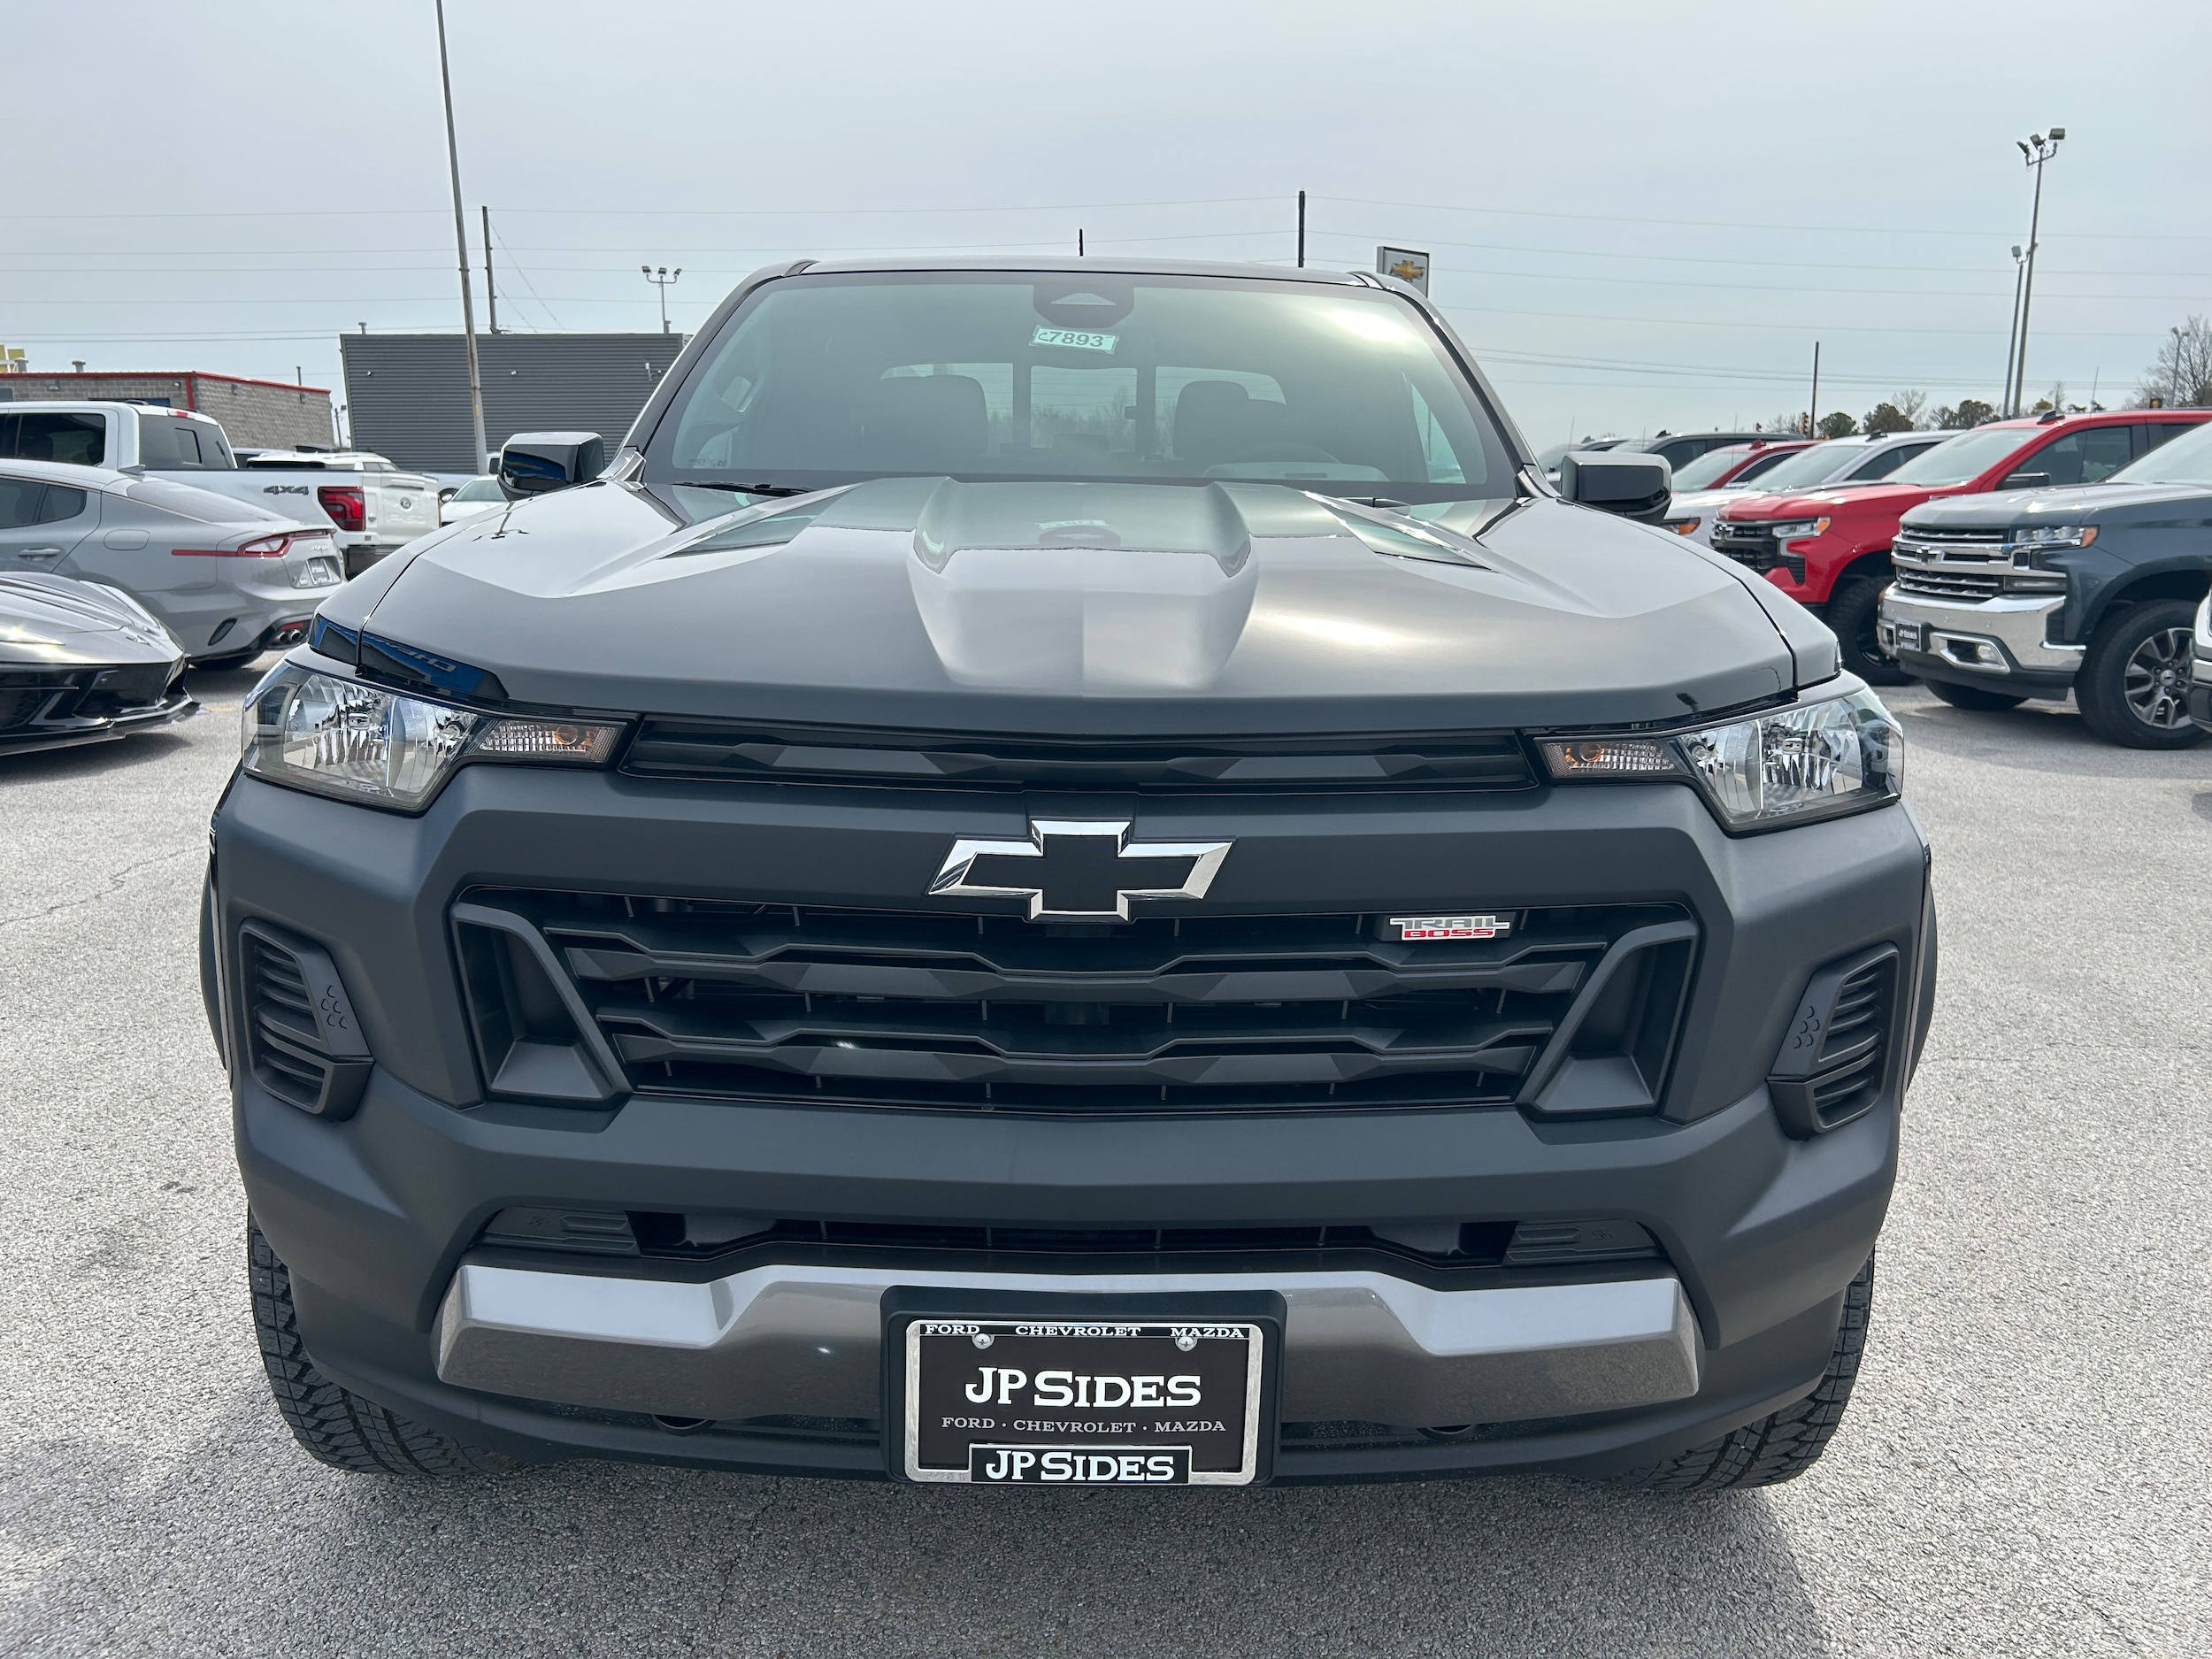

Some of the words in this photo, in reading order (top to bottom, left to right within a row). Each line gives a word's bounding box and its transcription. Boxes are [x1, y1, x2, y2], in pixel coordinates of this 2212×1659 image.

[1389, 915, 1510, 929] TRAIL
[1403, 928, 1494, 939] BOSS
[925, 1324, 981, 1336] FORD
[1015, 1325, 1141, 1338] CHEVROLET
[1170, 1326, 1245, 1339] MAZDA
[964, 1366, 1028, 1406] JP
[1033, 1369, 1202, 1409] SIDES
[941, 1417, 996, 1430] FORD
[1012, 1419, 1137, 1433] CHEVROLET
[1154, 1420, 1227, 1432] MAZDA
[985, 1450, 1037, 1481] JP
[1040, 1452, 1176, 1482] SIDES
